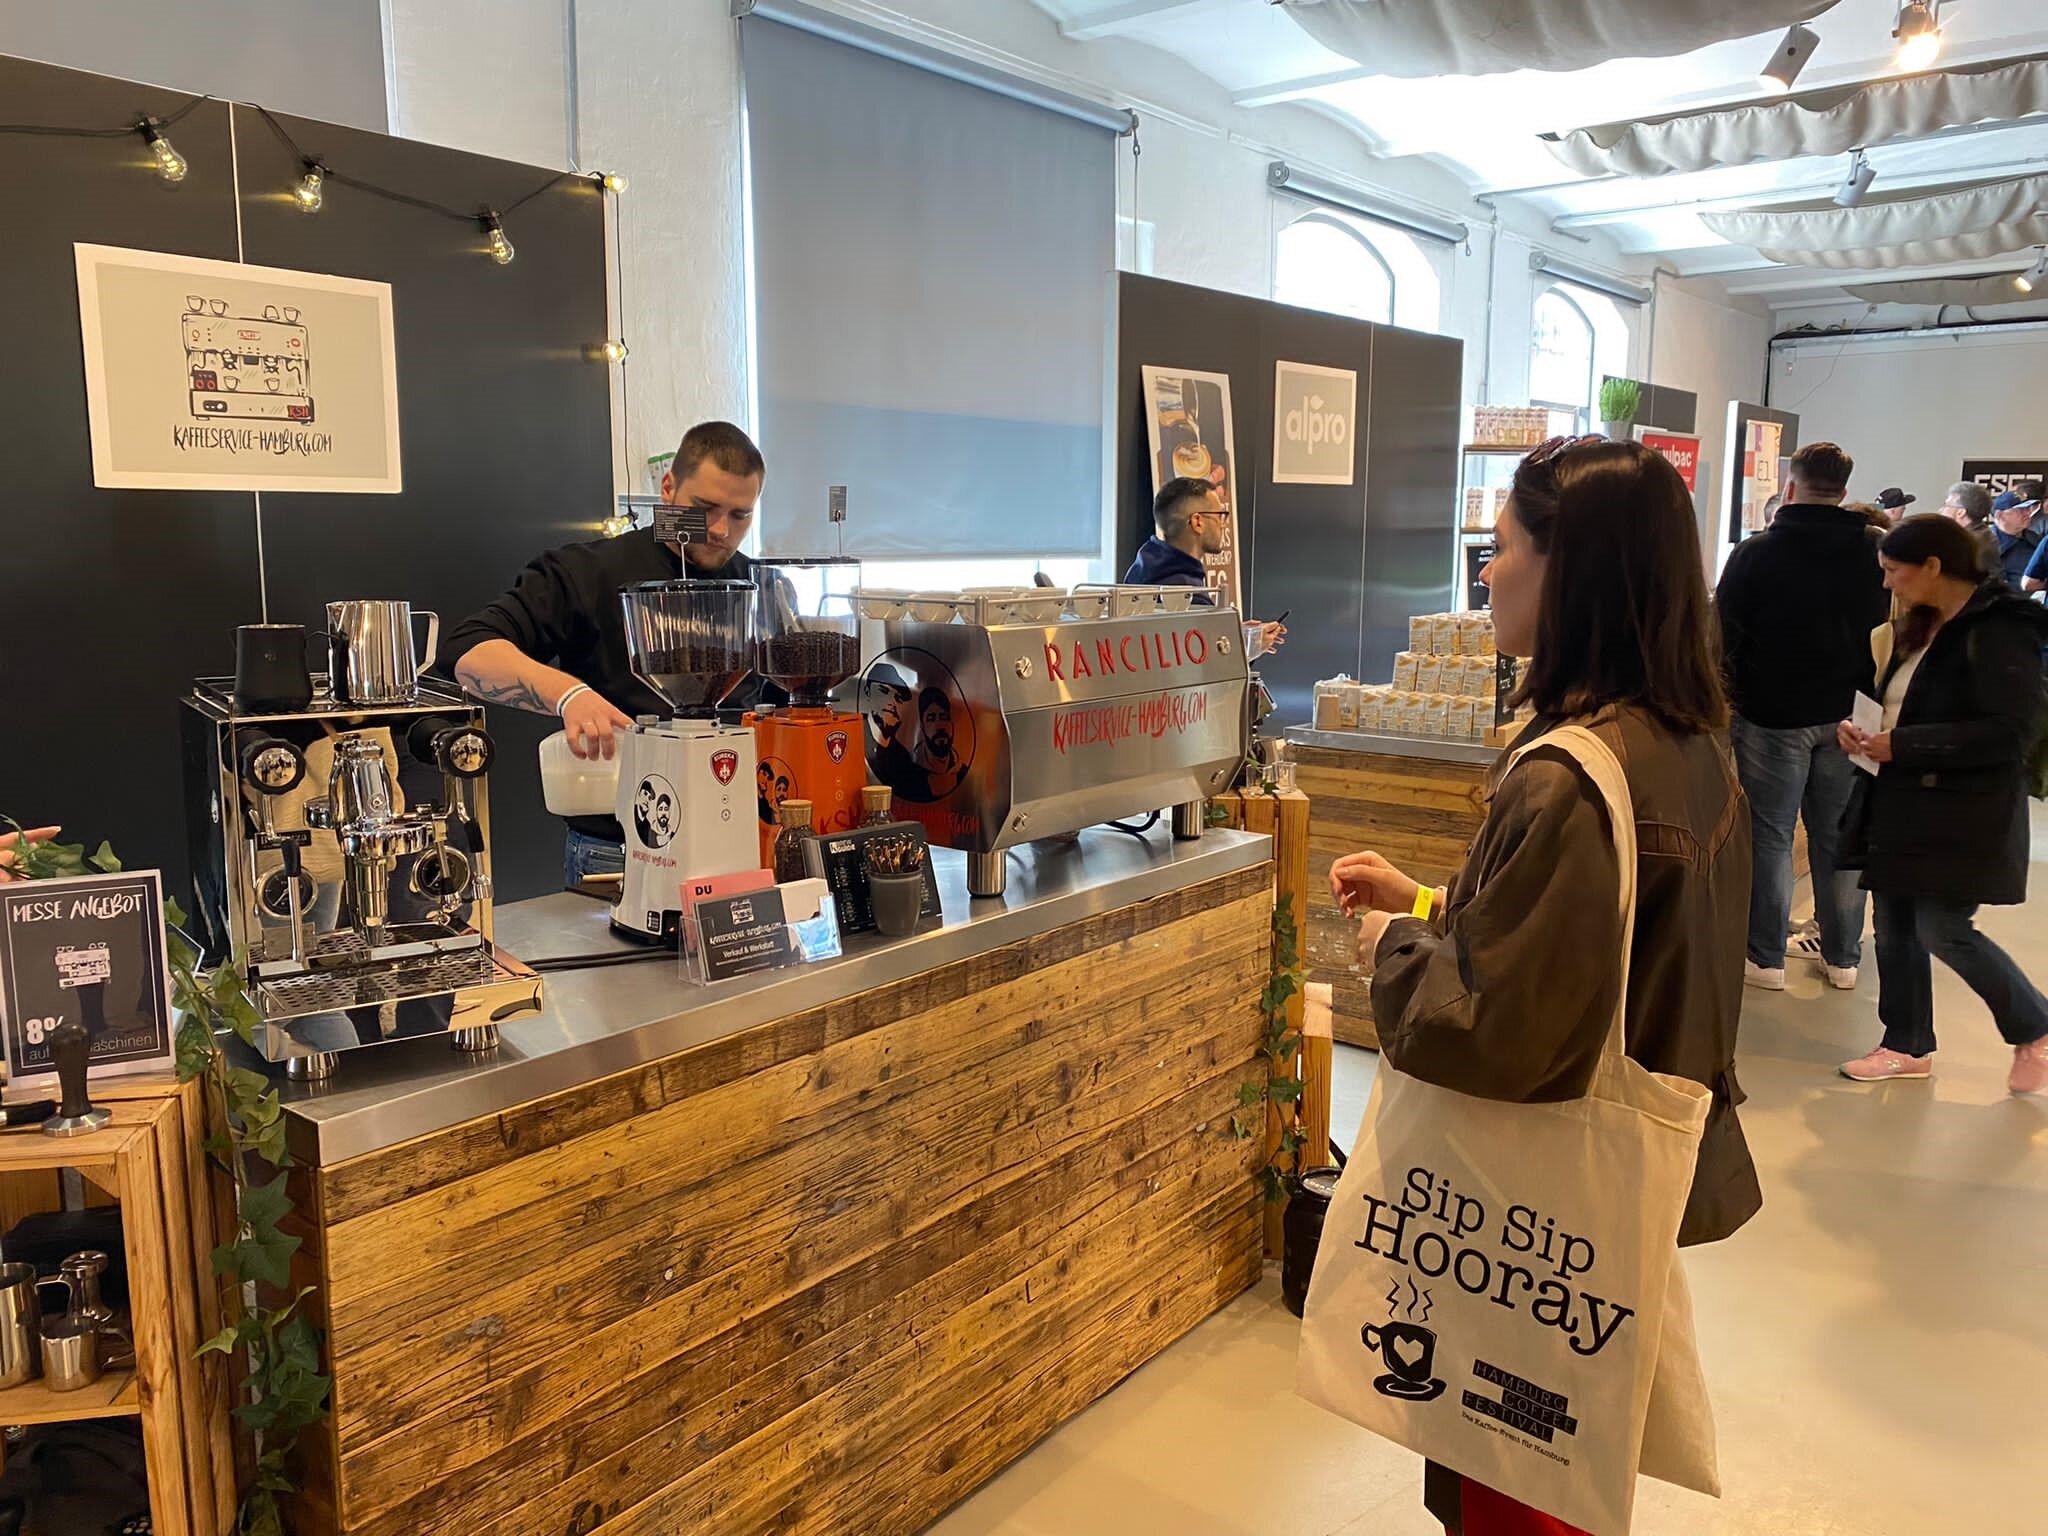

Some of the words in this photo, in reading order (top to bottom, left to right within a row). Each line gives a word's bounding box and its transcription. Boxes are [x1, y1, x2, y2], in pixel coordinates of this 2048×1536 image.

[1286, 395, 1346, 455] alpro
[1044, 629, 1208, 682] RANCILIO
[12, 901, 62, 923] MESSE
[70, 893, 145, 919] ANGEBOT
[695, 885, 712, 896] DU
[90, 1033, 152, 1052] aschinen
[1400, 1167, 1485, 1239] Sip
[1501, 1205, 1595, 1280] Sip
[1354, 1194, 1635, 1356] Hooray
[1475, 1361, 1565, 1410] HAMBURG
[1464, 1392, 1550, 1440] FESTIVAL
[1504, 1392, 1575, 1432] COFFEE
